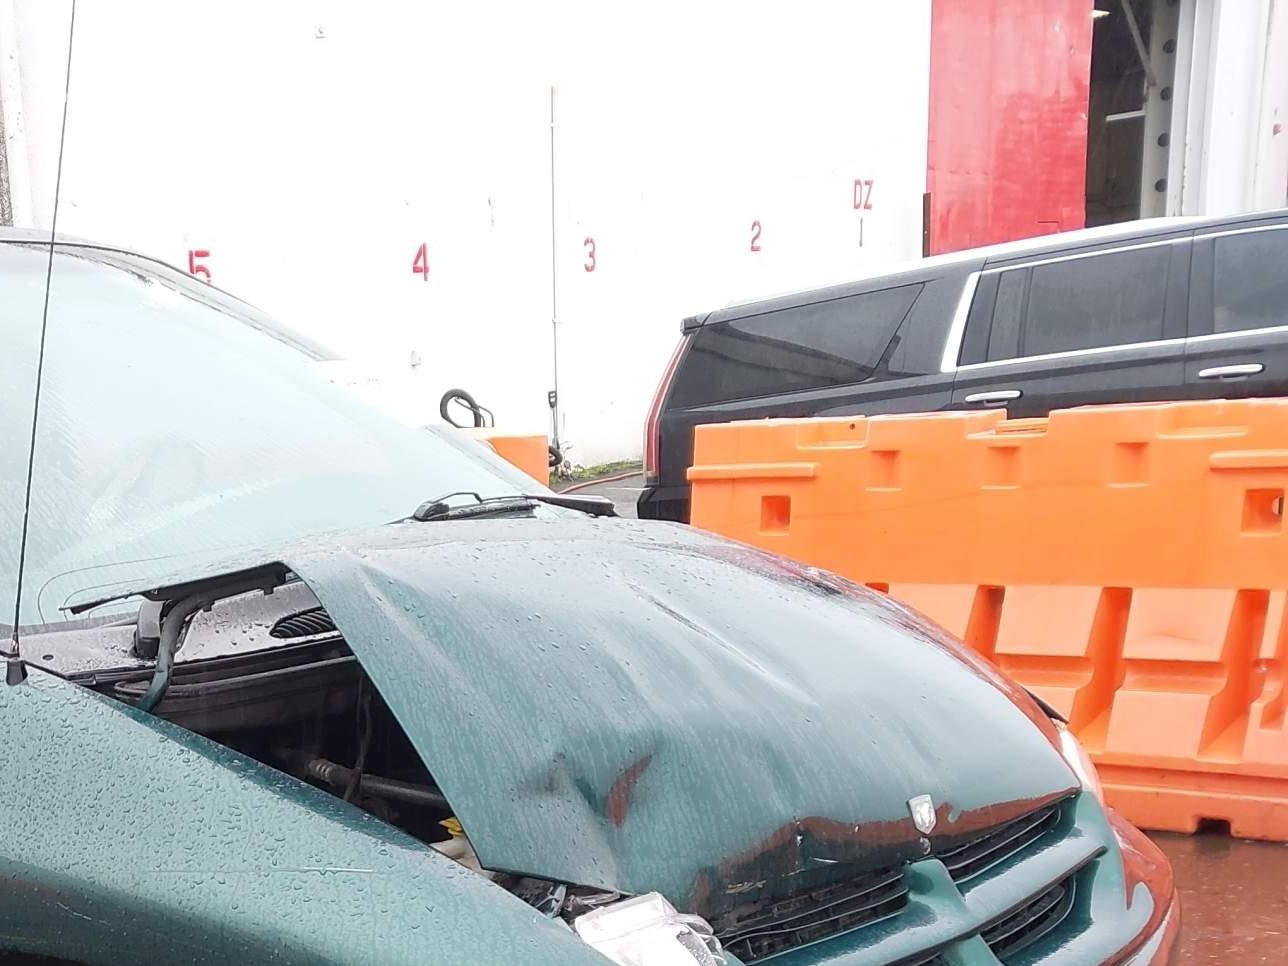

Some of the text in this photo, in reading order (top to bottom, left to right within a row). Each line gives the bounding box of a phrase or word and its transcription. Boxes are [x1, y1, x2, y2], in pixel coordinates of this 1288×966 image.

[854, 179, 873, 209] DZ
[751, 220, 761, 251] 2
[189, 250, 210, 282] 5
[412, 243, 429, 281] 4
[584, 238, 595, 272] 3
